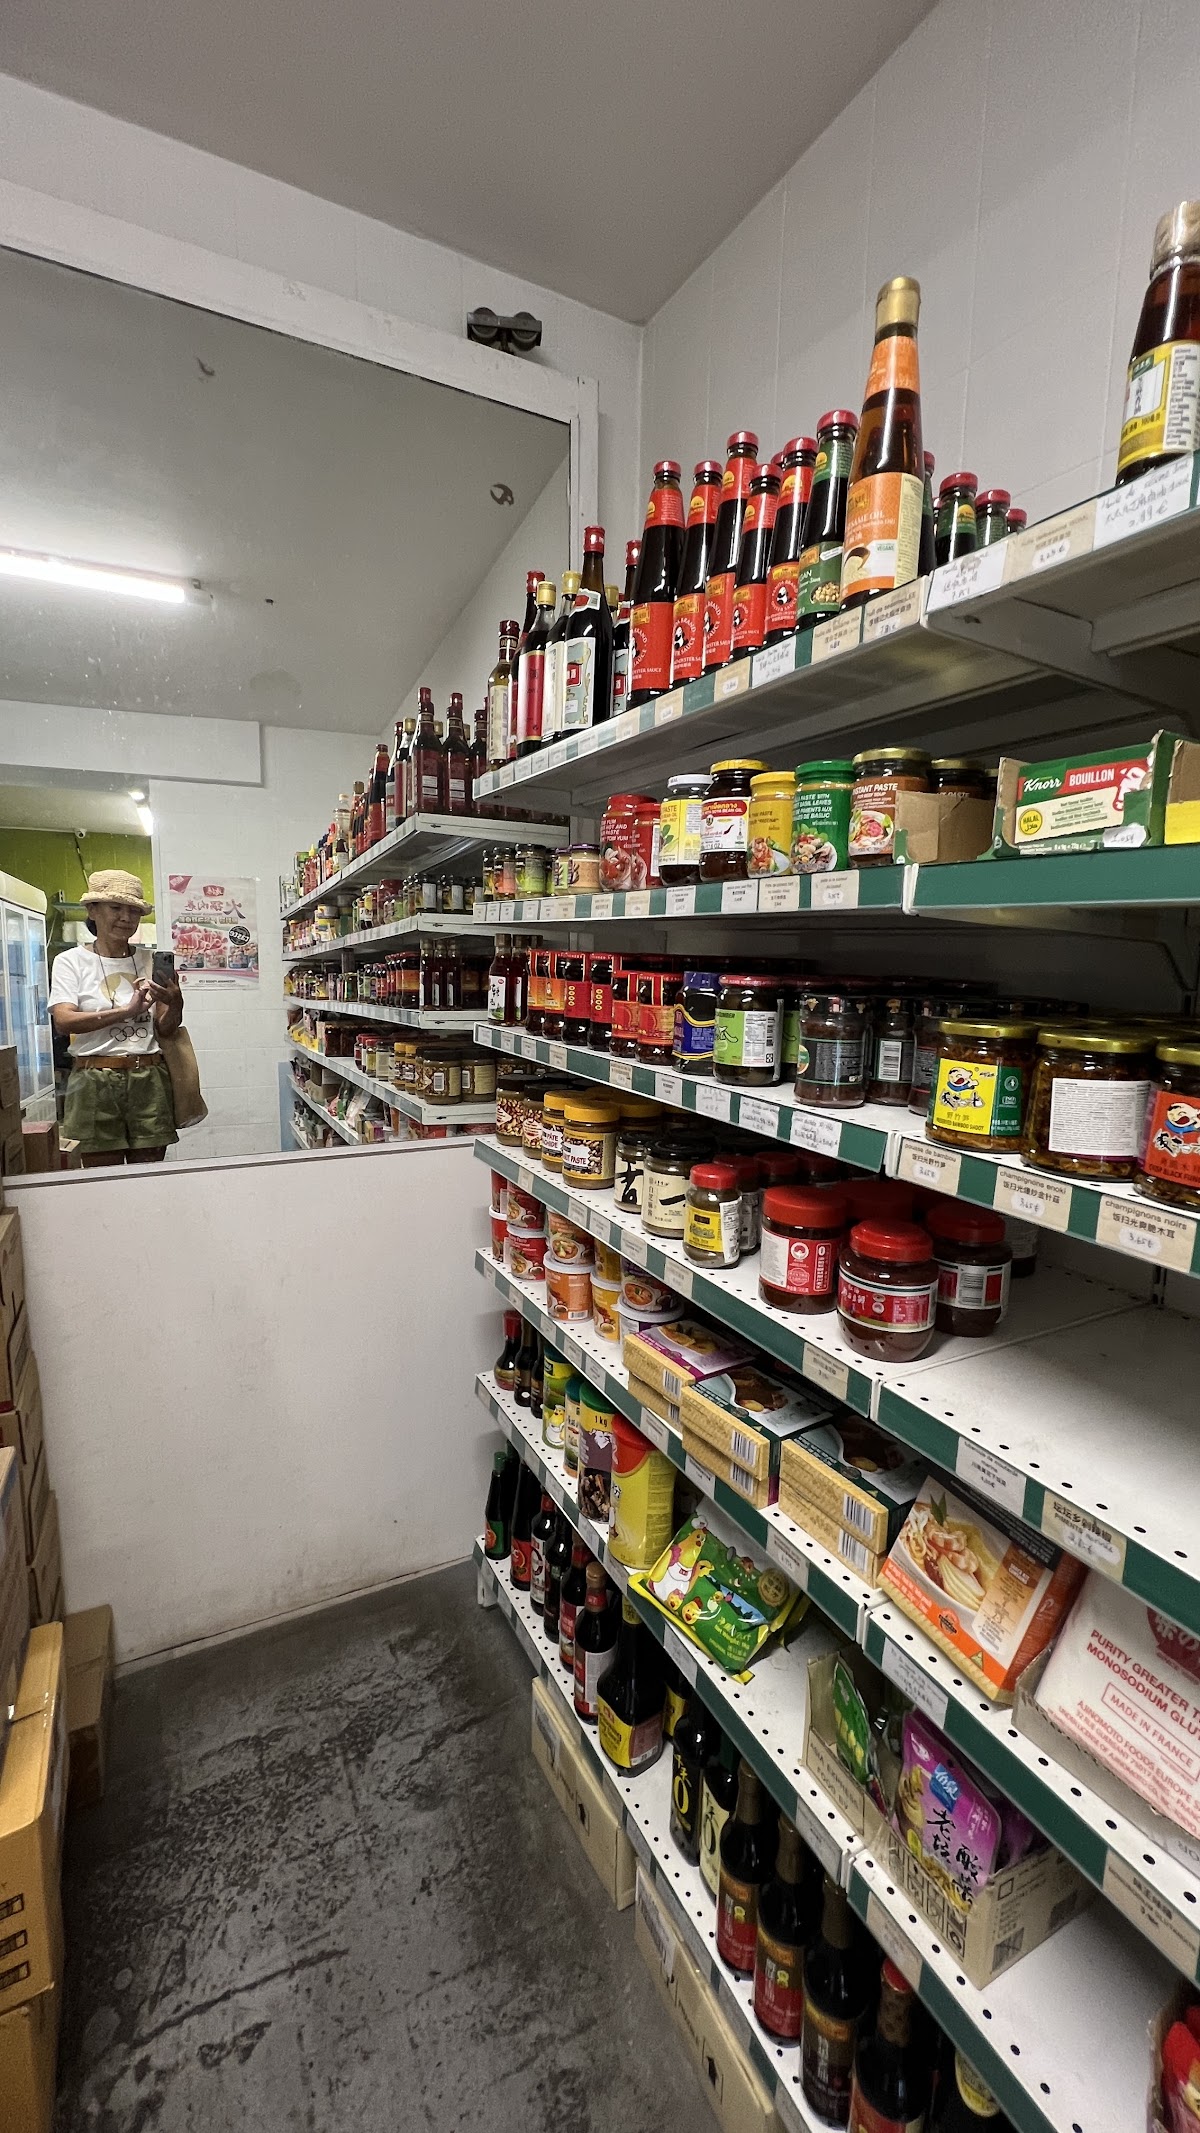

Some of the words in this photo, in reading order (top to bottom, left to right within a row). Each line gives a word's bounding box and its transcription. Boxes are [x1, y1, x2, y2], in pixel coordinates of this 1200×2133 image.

[1024, 777, 1062, 792] Knorr
[1069, 768, 1115, 787] BOUILLON
[874, 783, 898, 791] PASTE
[1023, 814, 1039, 824] HALAL
[952, 1120, 969, 1129] BAMBOO
[571, 1156, 587, 1165] PASTE
[924, 1148, 932, 1156] de
[933, 1151, 957, 1163] bambou
[1163, 1168, 1182, 1178] BLACK
[999, 1170, 1045, 1188] champignons
[1046, 1183, 1067, 1195] enoki
[1105, 1200, 1162, 1222] champignons
[1164, 1218, 1187, 1230] noirs
[600, 1416, 608, 1428] kg
[1055, 1513, 1083, 1533] PIMENTS
[1086, 1642, 1168, 1712] MONOSODIUM
[1091, 1629, 1132, 1664] PURITY
[1132, 1663, 1190, 1712] GREATER
[1110, 1694, 1139, 1721] MADE
[1139, 1719, 1151, 1733] IN
[1151, 1729, 1194, 1769] FRANCE
[1077, 1700, 1124, 1744] AJINOMOTO
[1124, 1741, 1155, 1771] FOODS
[1155, 1766, 1192, 1801] EUROPE
